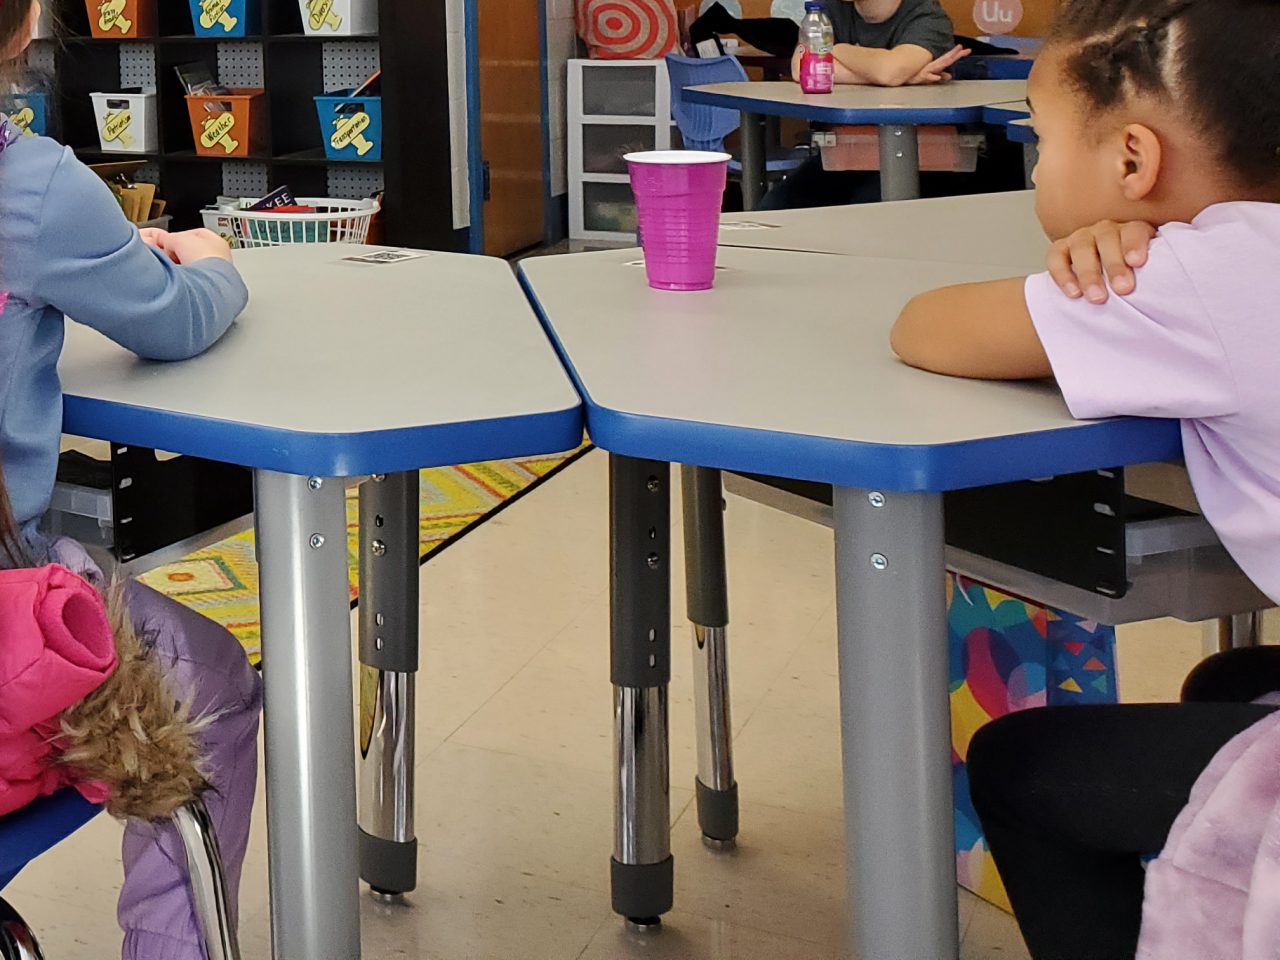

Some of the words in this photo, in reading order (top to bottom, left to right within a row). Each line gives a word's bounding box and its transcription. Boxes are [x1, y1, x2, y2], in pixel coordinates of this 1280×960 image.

[982, 0, 1013, 23] Uu
[205, 116, 232, 142] Weather
[332, 115, 367, 144] Transportation
